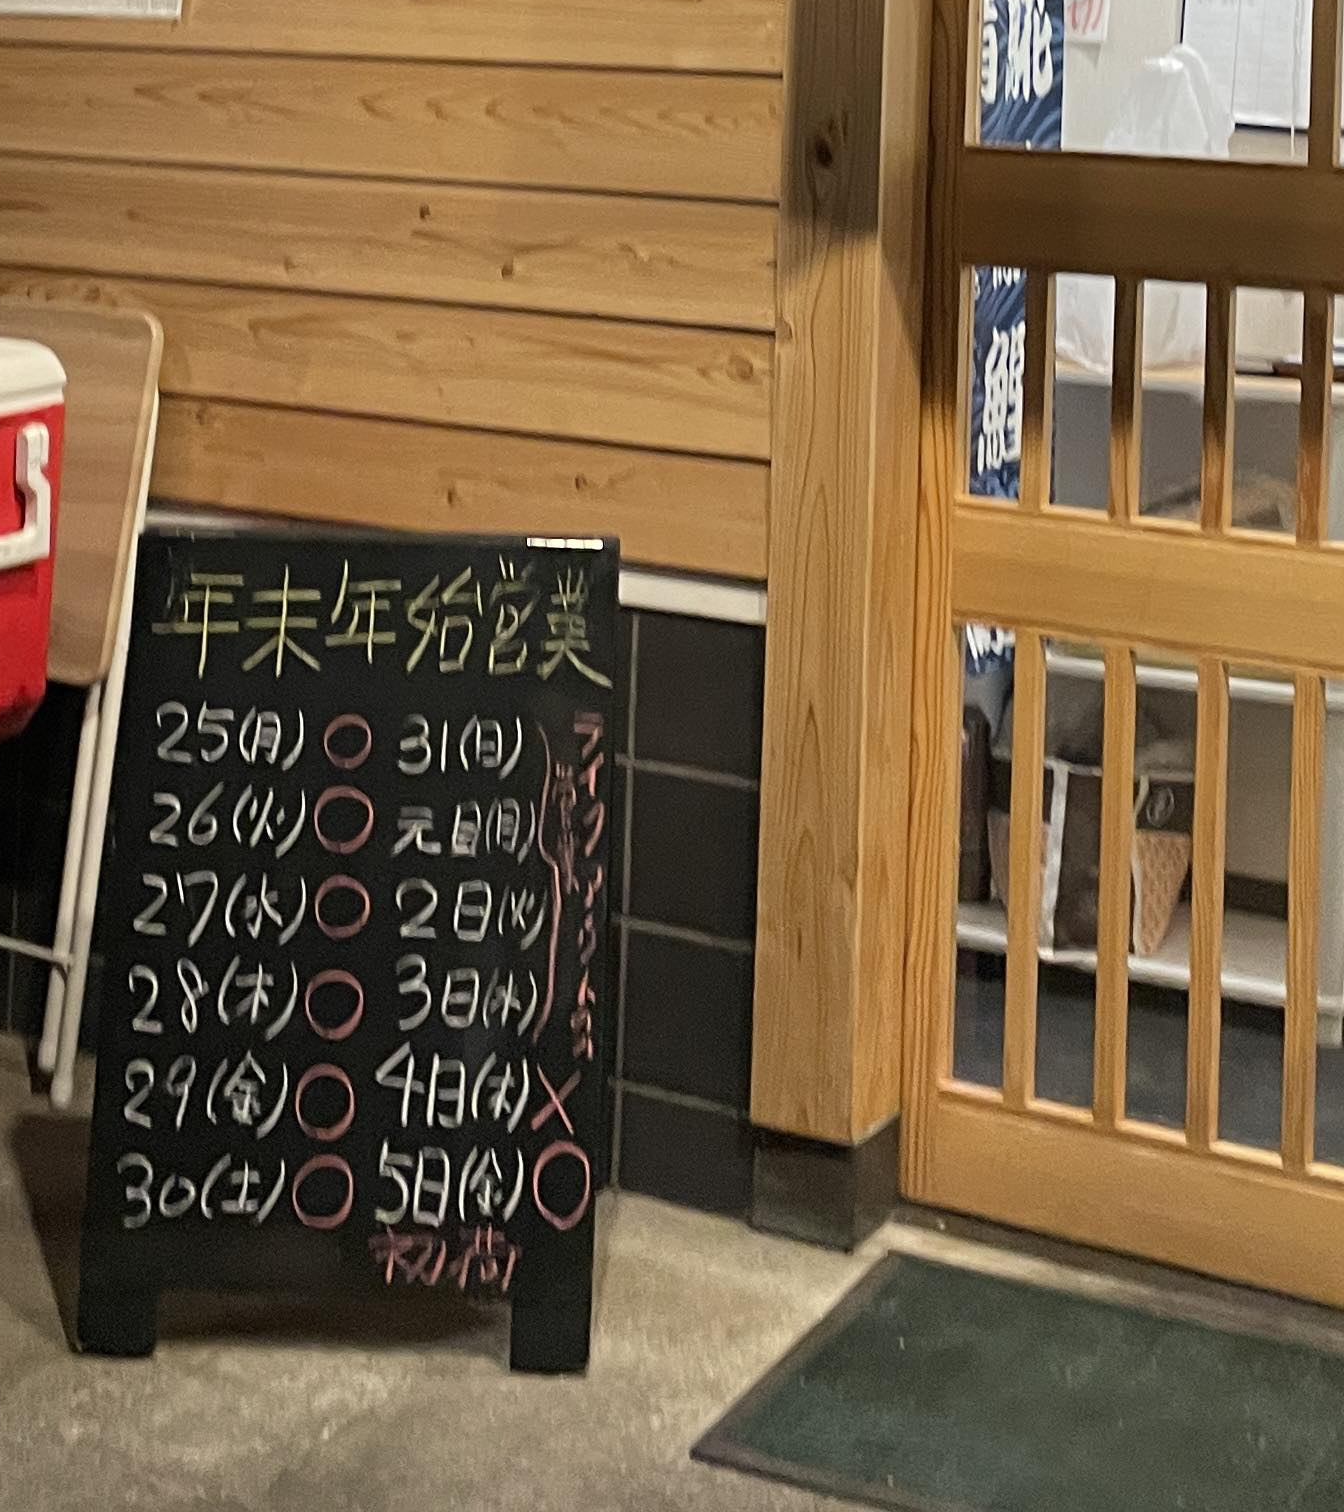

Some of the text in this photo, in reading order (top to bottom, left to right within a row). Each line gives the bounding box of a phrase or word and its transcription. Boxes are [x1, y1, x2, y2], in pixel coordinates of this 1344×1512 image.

[151, 553, 613, 688] 年末年始営業
[397, 713, 523, 780] 31(日)
[149, 781, 308, 859] 26(火)
[132, 871, 308, 948] 27(水)
[128, 955, 300, 1041] 28(木)
[123, 1049, 290, 1140] 29(金)
[116, 1152, 287, 1230] 30(土)
[375, 1137, 525, 1228] 5日(金)
